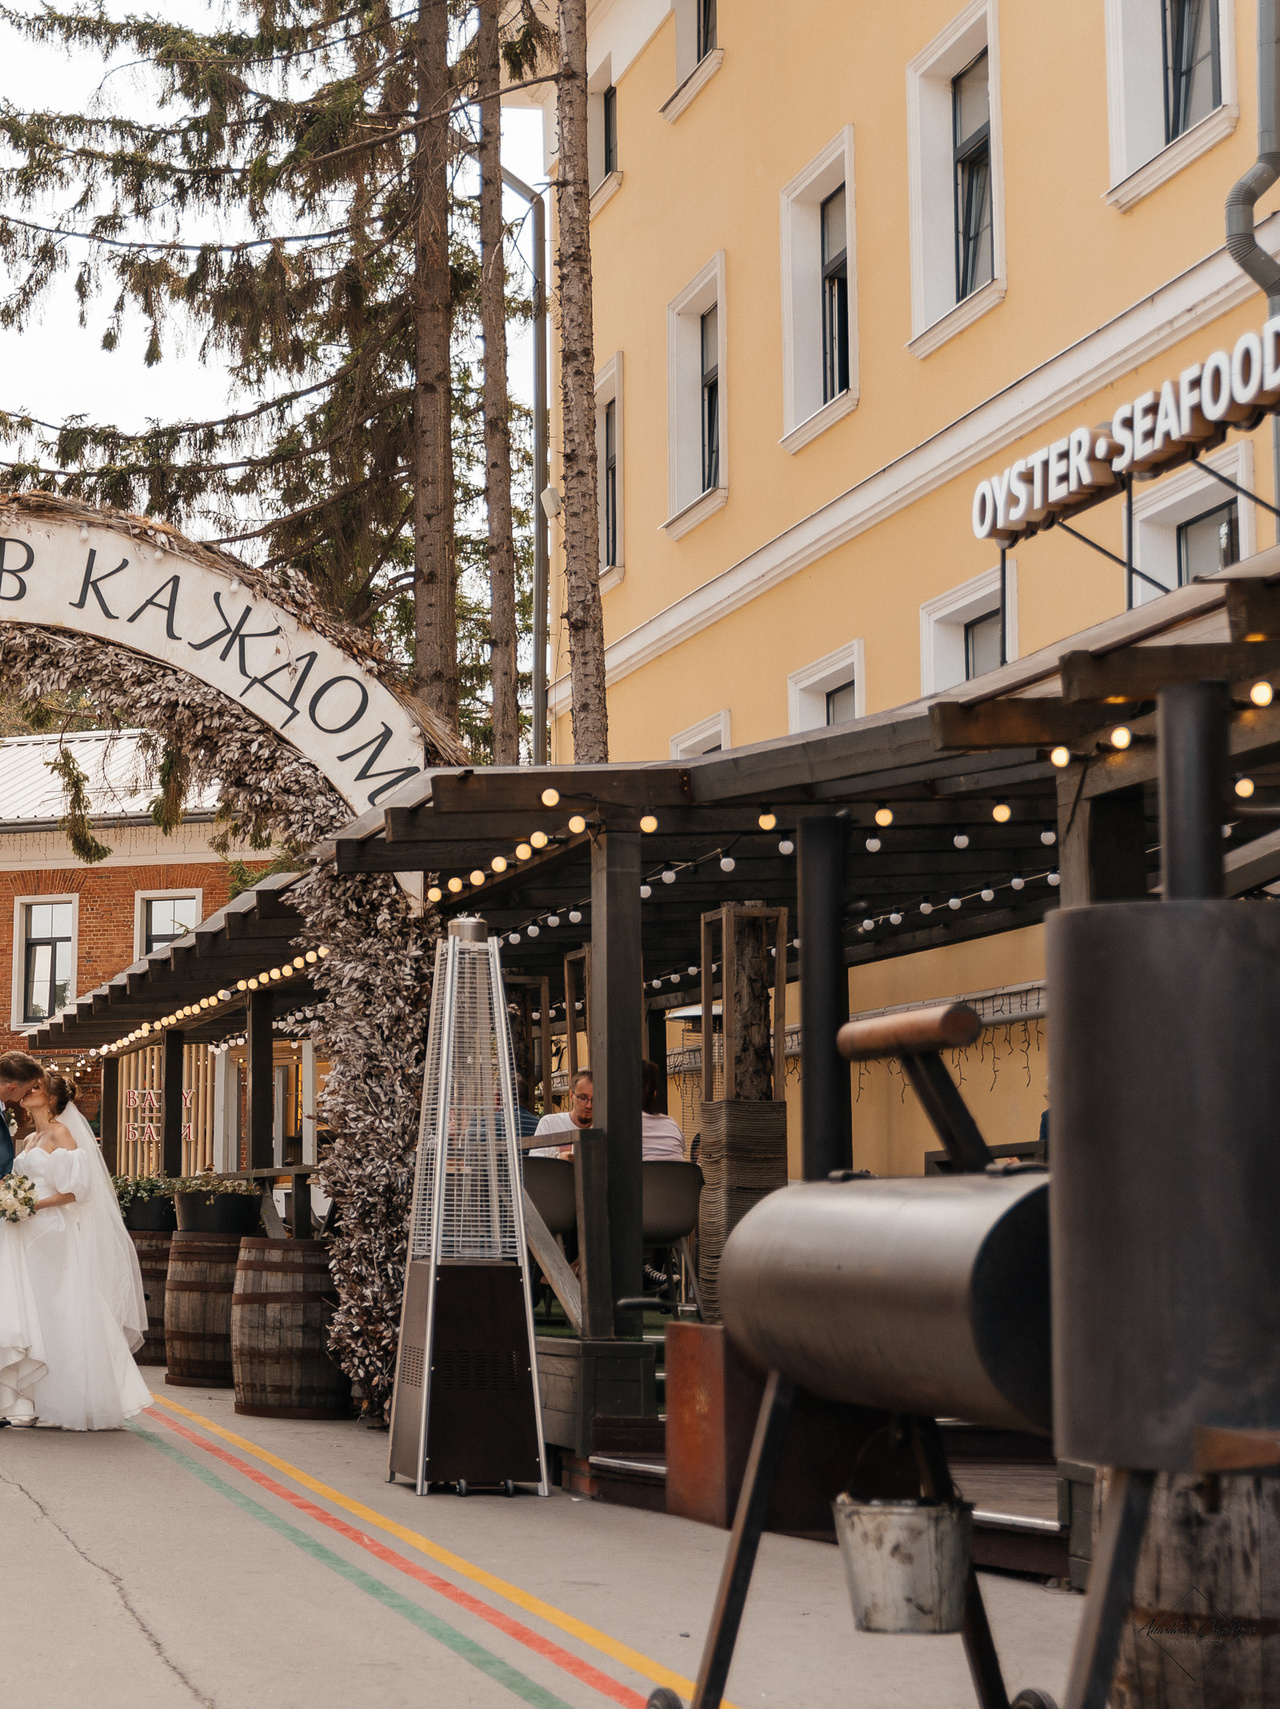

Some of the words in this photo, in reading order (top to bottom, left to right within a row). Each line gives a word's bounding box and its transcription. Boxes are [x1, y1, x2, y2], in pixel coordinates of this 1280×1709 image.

[972, 427, 1094, 539] OYSTER
[1111, 315, 1280, 472] SEAFOOD
[69, 548, 421, 807] КАЖДОМ
[126, 1089, 195, 1108] BAY
[126, 1123, 195, 1141] БАИ
